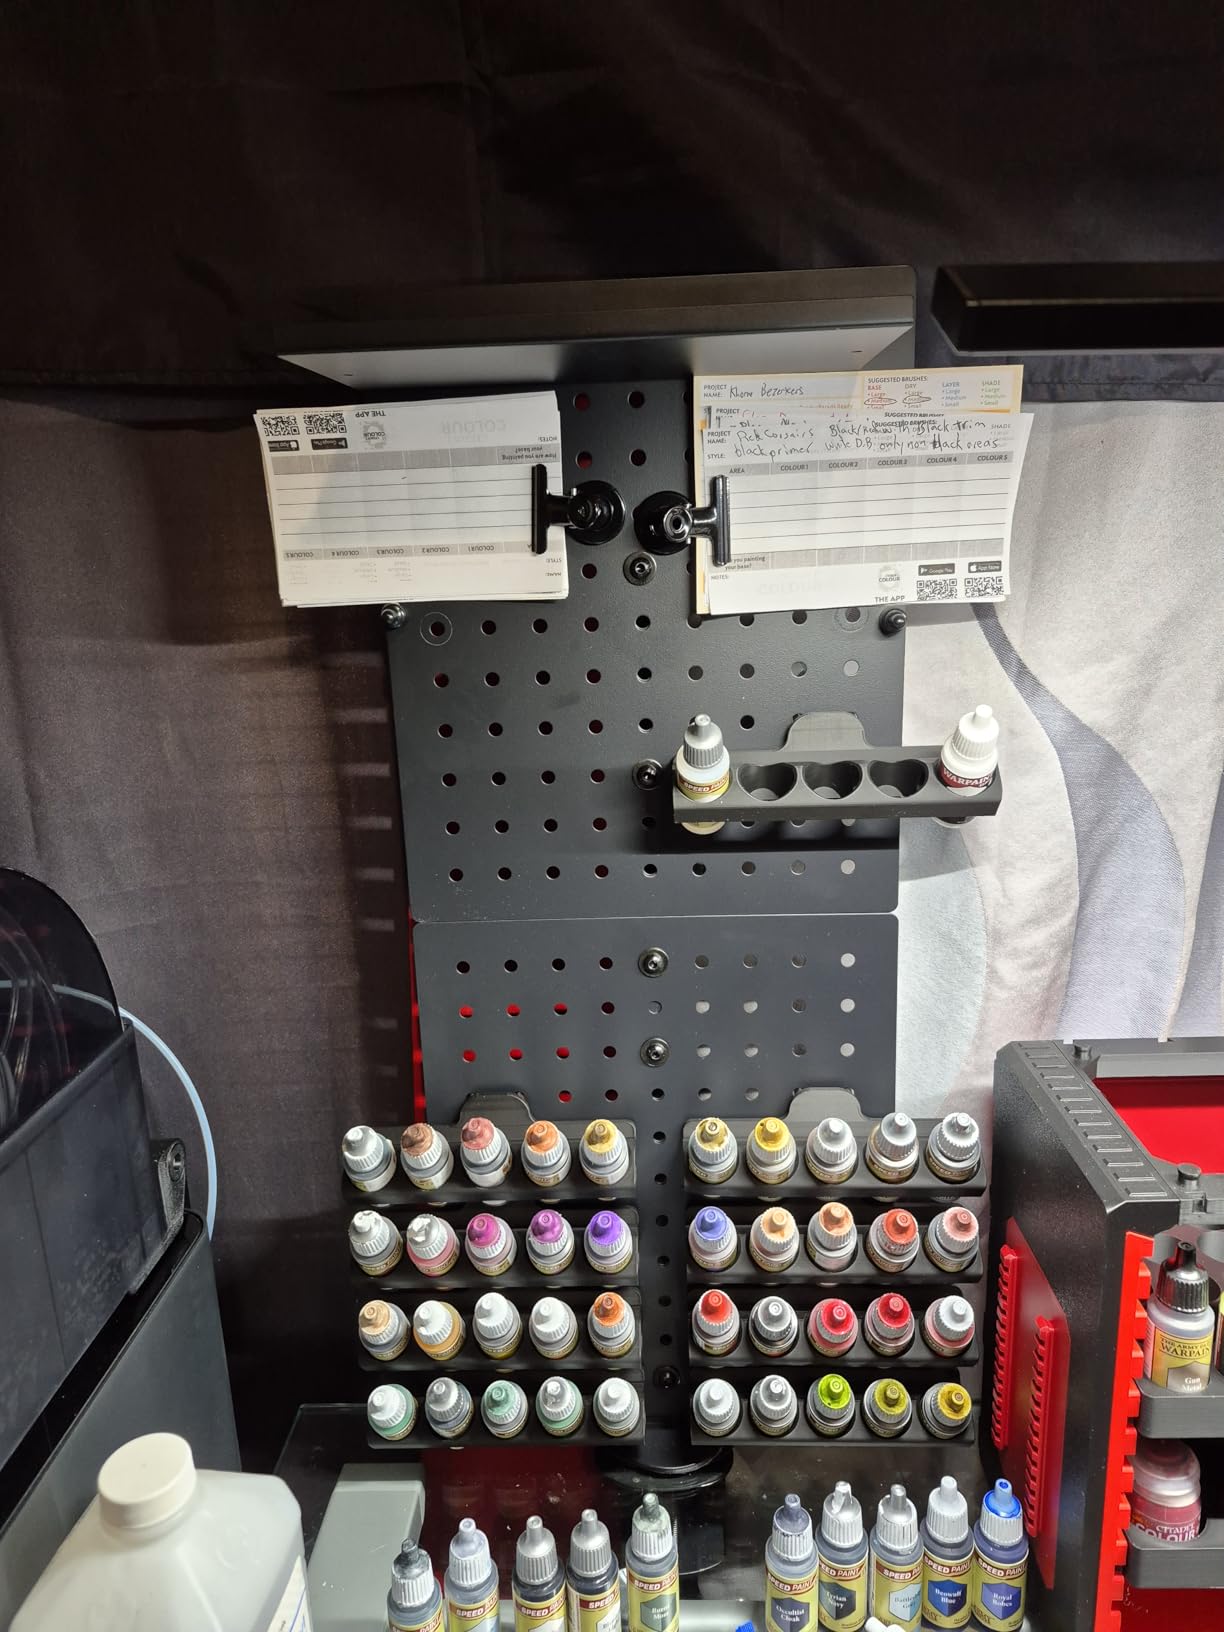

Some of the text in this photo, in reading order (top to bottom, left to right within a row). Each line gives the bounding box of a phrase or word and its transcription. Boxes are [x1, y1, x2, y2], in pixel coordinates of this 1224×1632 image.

[369, 410, 386, 418] THE
[1184, 1376, 1201, 1384] Gun
[924, 1555, 950, 1574] SPEED
[978, 1557, 1004, 1577] SPEED
[837, 1567, 860, 1577] PAINT
[883, 1568, 912, 1580] SPEED
[633, 1579, 661, 1591] SPEED
[767, 1573, 791, 1592] SPEED
[589, 1594, 614, 1609] SPEED
[941, 1594, 956, 1604] Blue
[992, 1592, 1013, 1602] Royal
[992, 1598, 1013, 1608] Robes
[456, 1606, 484, 1617] SPEED
[521, 1606, 550, 1617] SPEED
[780, 1613, 801, 1623] Cloak
